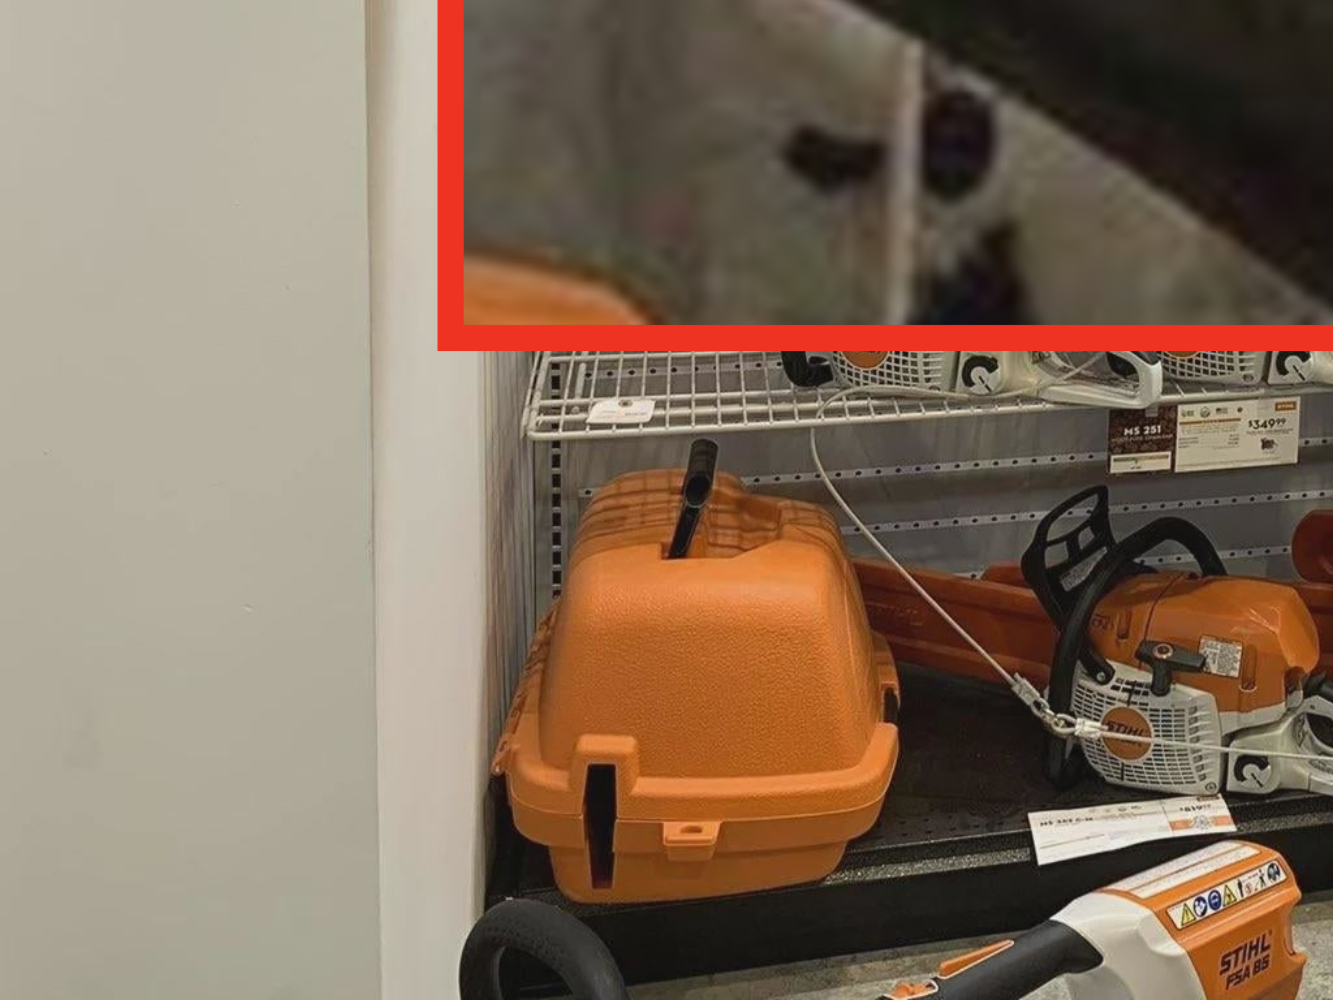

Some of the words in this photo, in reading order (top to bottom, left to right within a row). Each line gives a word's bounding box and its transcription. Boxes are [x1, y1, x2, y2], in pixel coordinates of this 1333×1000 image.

[1123, 426, 1140, 436] MS
[1143, 425, 1162, 435] 251
[1106, 720, 1144, 737] STIHL
[1219, 931, 1271, 976] STIHL
[1225, 964, 1251, 991] FSA
[1252, 953, 1270, 976] 85
